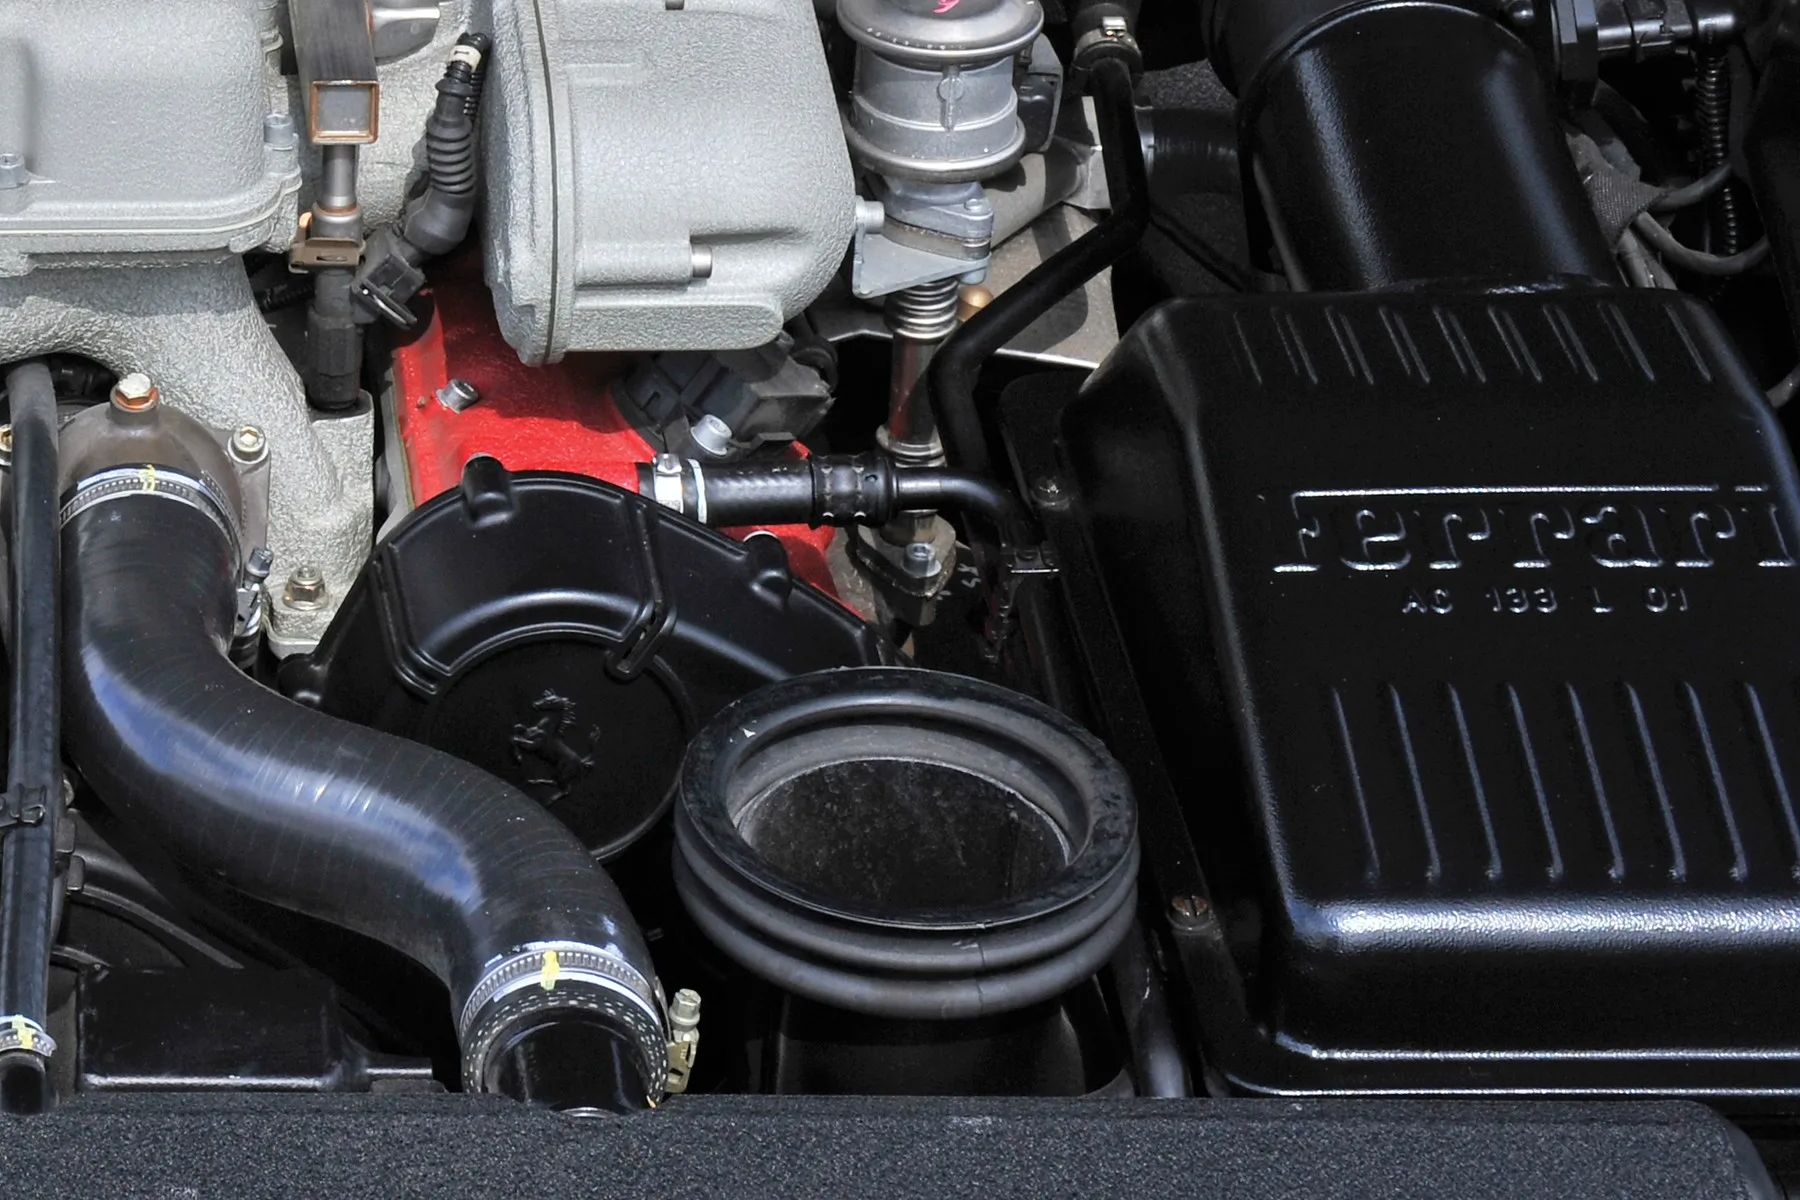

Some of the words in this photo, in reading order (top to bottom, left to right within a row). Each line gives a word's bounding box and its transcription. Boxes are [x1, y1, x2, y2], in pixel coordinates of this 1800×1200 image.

[1271, 482, 1798, 573] Ferrari
[1401, 586, 1454, 615] AC
[1484, 586, 1558, 614] 133
[1644, 586, 1689, 614] 01
